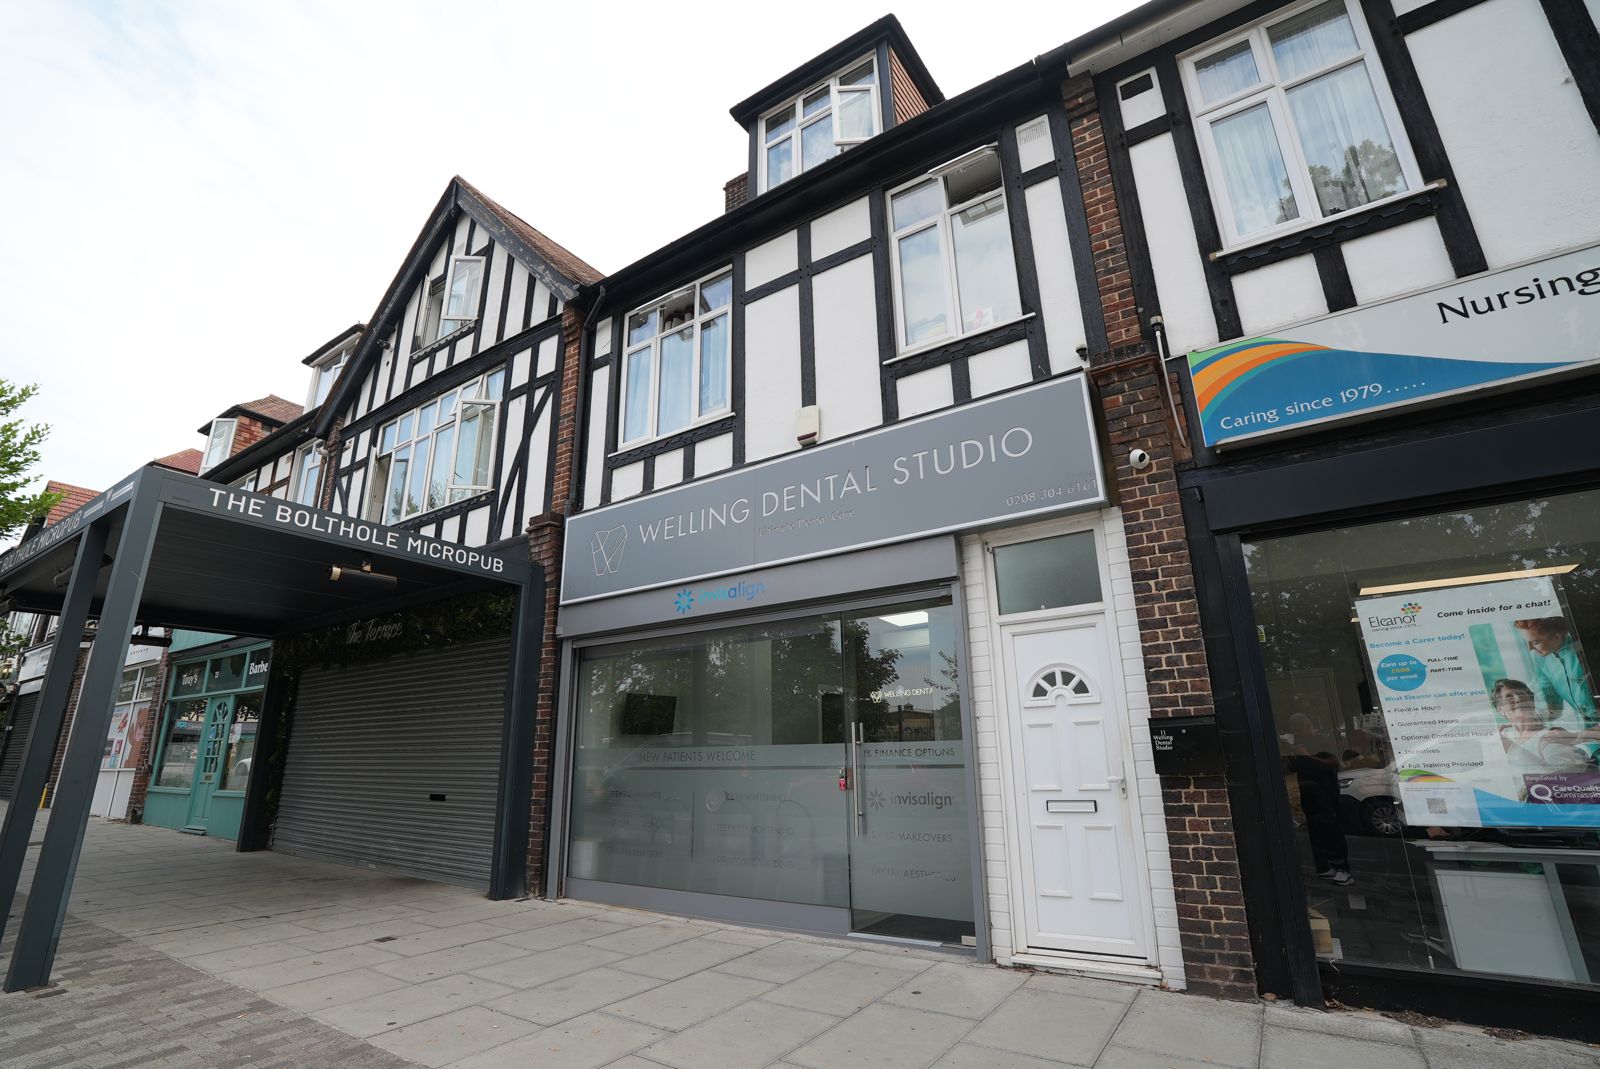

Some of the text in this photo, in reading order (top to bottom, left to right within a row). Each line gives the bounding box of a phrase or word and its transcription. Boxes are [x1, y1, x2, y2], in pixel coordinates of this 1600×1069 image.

[1436, 266, 1600, 325] Nursing
[1220, 409, 1279, 430] Caring
[1285, 396, 1333, 416] since
[639, 427, 1033, 545] WELLING DENTAL STUDIO
[1006, 491, 1036, 507] 0208
[1040, 487, 1062, 501] 304
[36, 510, 83, 552] MICROPUB
[209, 487, 504, 573] THE BOLTHOLE MICROPUB
[1368, 614, 1417, 628] Eleanor
[1437, 610, 1464, 618] Come
[1467, 606, 1496, 615] inside
[1525, 600, 1551, 608] chat!
[639, 750, 756, 762] NEW PATIENTS WELCOME
[875, 748, 912, 758] FINANCE
[915, 747, 955, 758] OPTIONS
